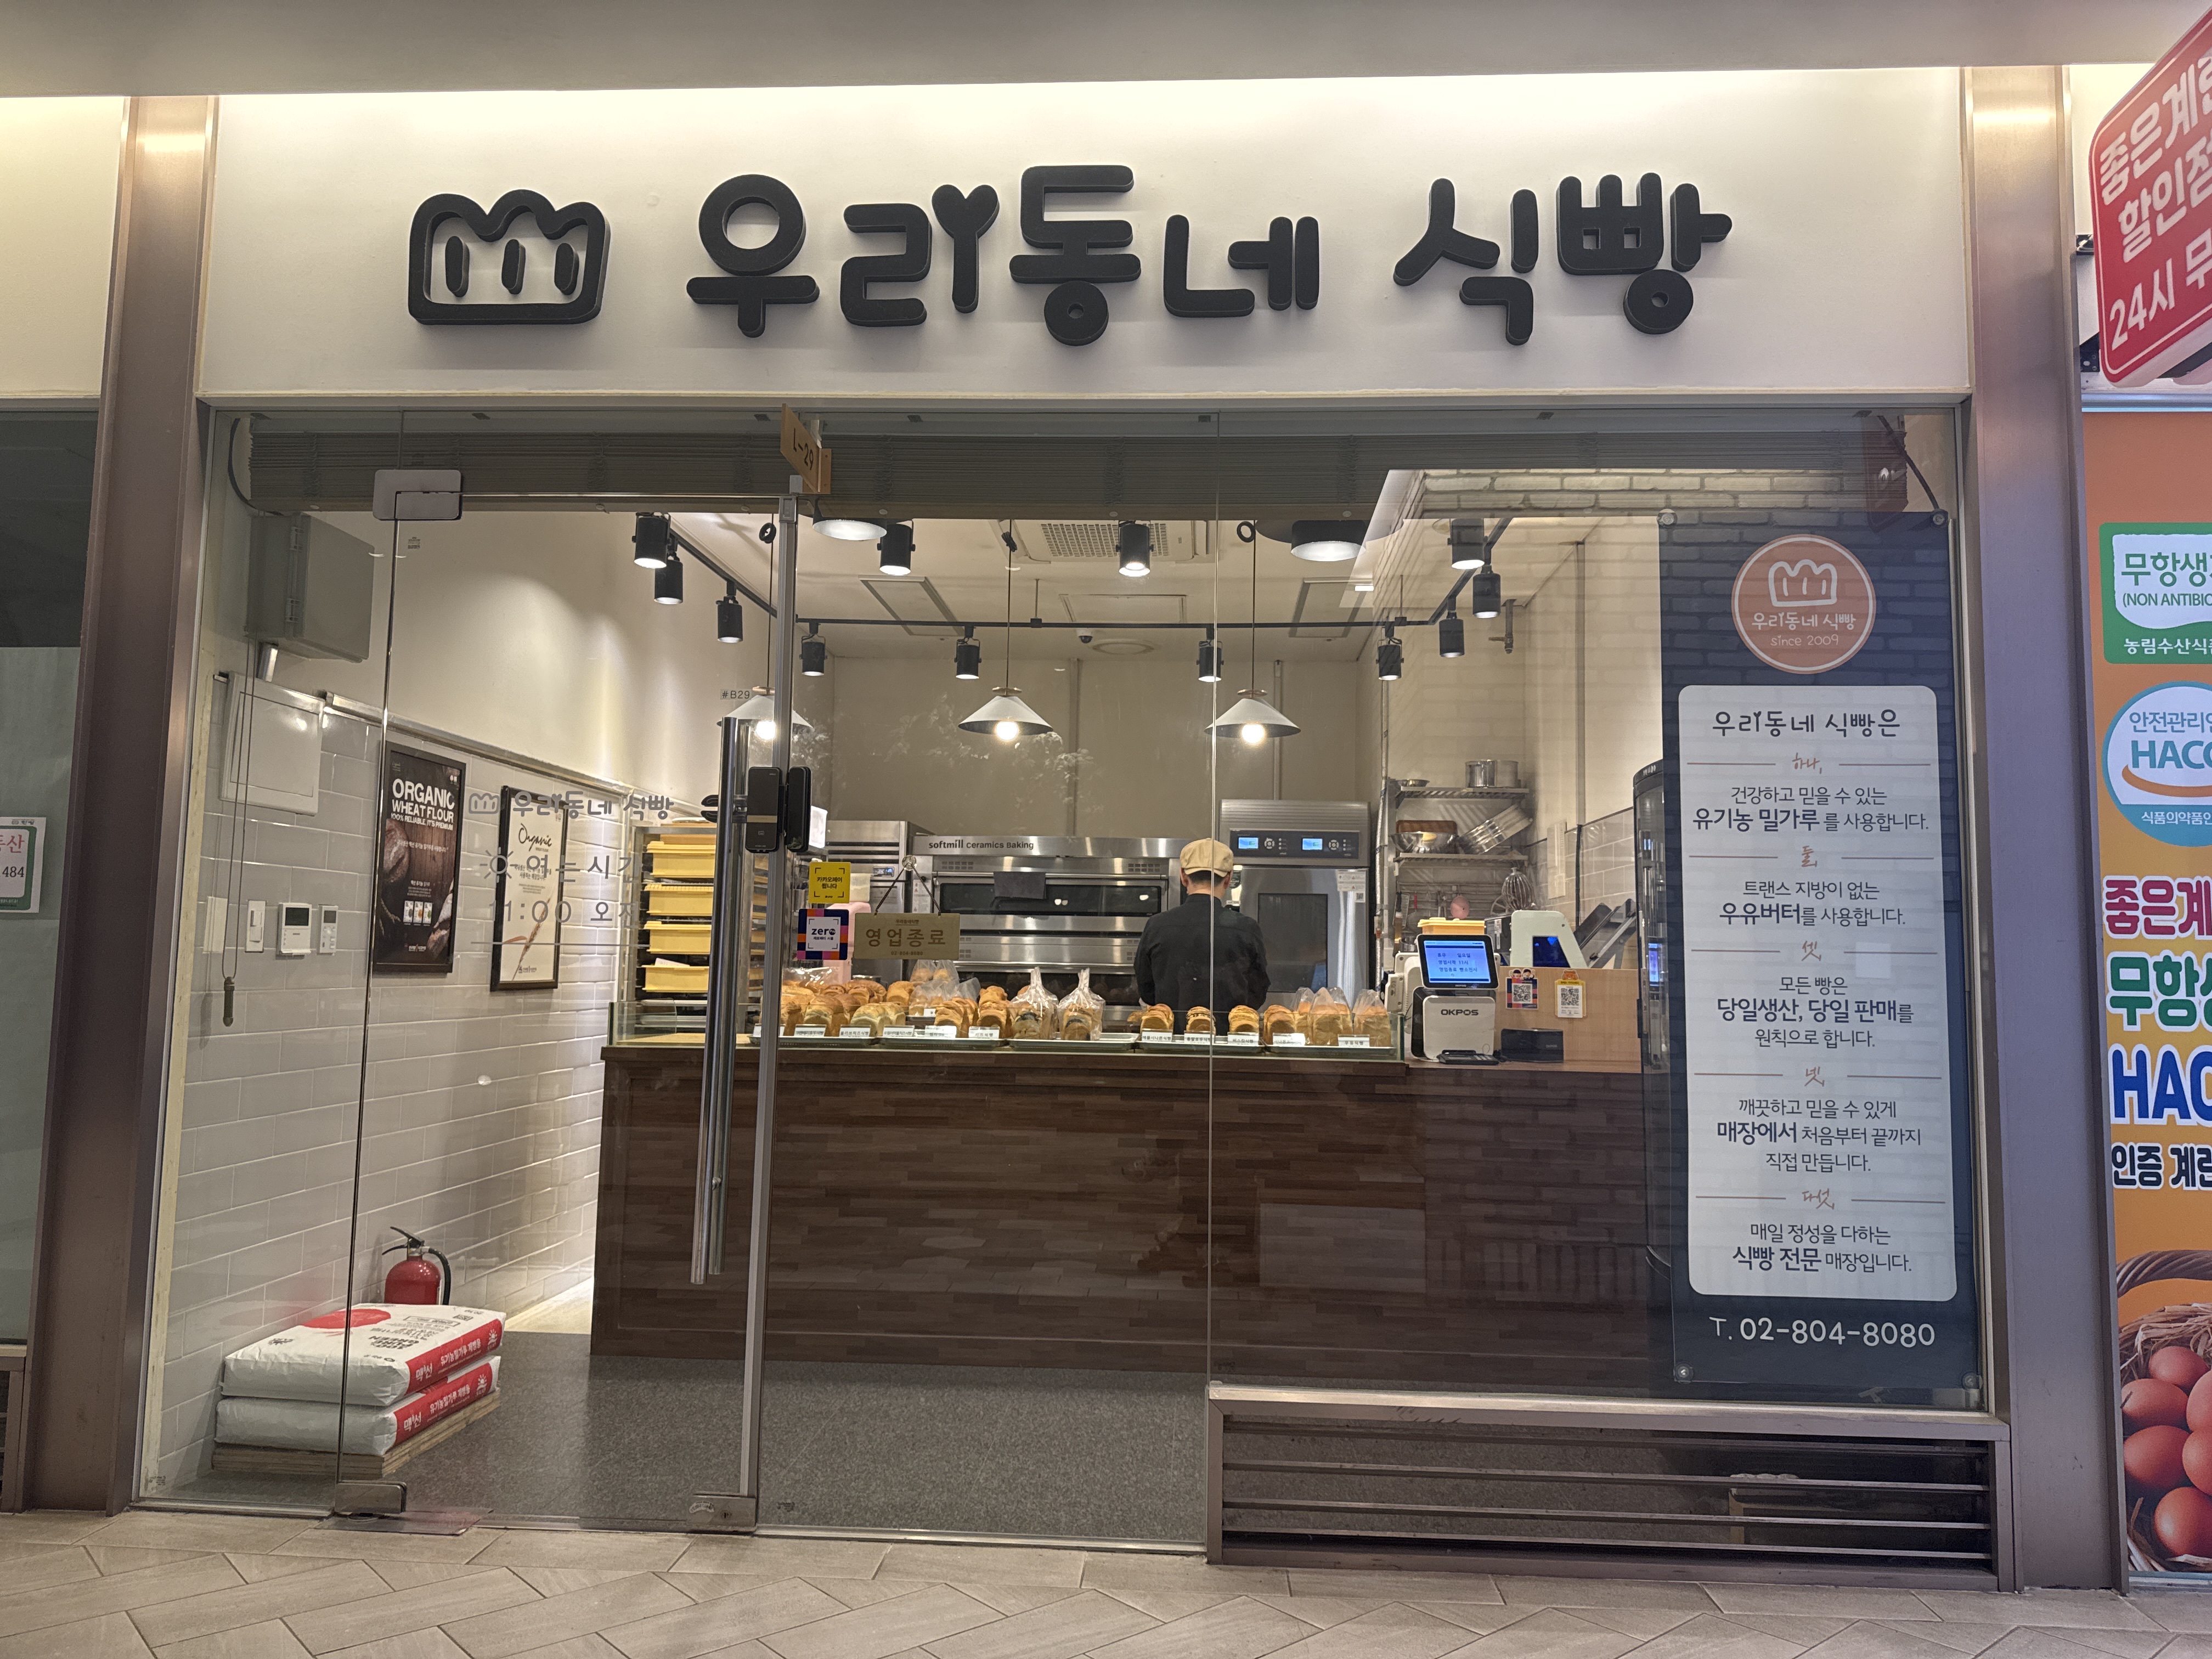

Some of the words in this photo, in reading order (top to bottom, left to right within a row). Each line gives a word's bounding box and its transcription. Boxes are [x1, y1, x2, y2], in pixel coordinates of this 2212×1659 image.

[686, 165, 1321, 346] 우리동네
[1393, 172, 1732, 346] 식빵
[2109, 258, 2175, 351] 24시
[2121, 552, 2212, 587] 무항생
[2123, 593, 2158, 608] (NON
[1752, 612, 1818, 630] 우리동네
[1822, 613, 1857, 630] 식빵
[1770, 635, 1801, 646] since
[1807, 634, 1839, 646] 2009
[2124, 638, 2212, 654] 농림수산식
[722, 690, 750, 699] #B29
[1713, 711, 1814, 737] 우리동네
[1825, 709, 1900, 737] 식빵은
[392, 778, 455, 810] ORGANIC
[1731, 786, 1795, 805] 건강하고
[1799, 787, 1831, 805] 믿을
[1834, 788, 1850, 804] 수
[1855, 787, 1887, 805] 있는
[392, 799, 426, 817] WHEAT
[427, 806, 454, 823] FLOUR
[513, 791, 612, 819] 우리동네
[623, 795, 674, 821] 식빵
[1693, 809, 1754, 832] 유기농
[1759, 809, 1820, 832] 밀가루
[1844, 812, 1929, 832] 사용합니다.
[518, 822, 552, 851] Organic
[929, 839, 963, 849] softmill
[1006, 841, 1034, 850] Baking
[2, 866, 25, 878] 484
[1743, 881, 1791, 899] 트랜스
[1795, 881, 1842, 900] 지방이
[1847, 882, 1880, 900] 없는
[489, 900, 572, 923] 11:00
[1719, 902, 1817, 926] 우유버터를
[1820, 907, 1905, 927] 사용합니다.
[866, 928, 946, 947] 영업종료
[1779, 977, 1811, 995] 모든
[1815, 976, 1848, 995] 빵은
[1717, 998, 1803, 1023] 당일생산,
[1808, 1000, 1849, 1023] 당일
[1854, 1000, 1914, 1023] 판매를
[1755, 1029, 1819, 1047] 원칙으로
[1822, 1030, 1875, 1048] 합니다.
[1739, 1098, 1802, 1118] 깨끗하고
[1806, 1099, 1839, 1119] 믿을
[1843, 1101, 1859, 1118] 수
[1864, 1101, 1897, 1120] 있게
[1717, 1121, 1797, 1146] 매장에서
[1802, 1126, 1867, 1146] 처음부터
[1871, 1128, 1921, 1147] 끝까지
[1766, 1153, 1797, 1172] 직접
[1802, 1153, 1871, 1173] 만듭니다.
[2112, 1145, 2162, 1186] 인증
[1751, 1223, 1784, 1243] 매일
[1787, 1224, 1837, 1244] 정성을
[1841, 1225, 1891, 1245] 다하는
[1732, 1246, 1774, 1271] 식빵
[1779, 1247, 1822, 1272] 전문
[1826, 1252, 1912, 1273] 매장입니다.
[1709, 1317, 1733, 1340] T.
[1740, 1317, 1936, 1348] 02-804-8080
